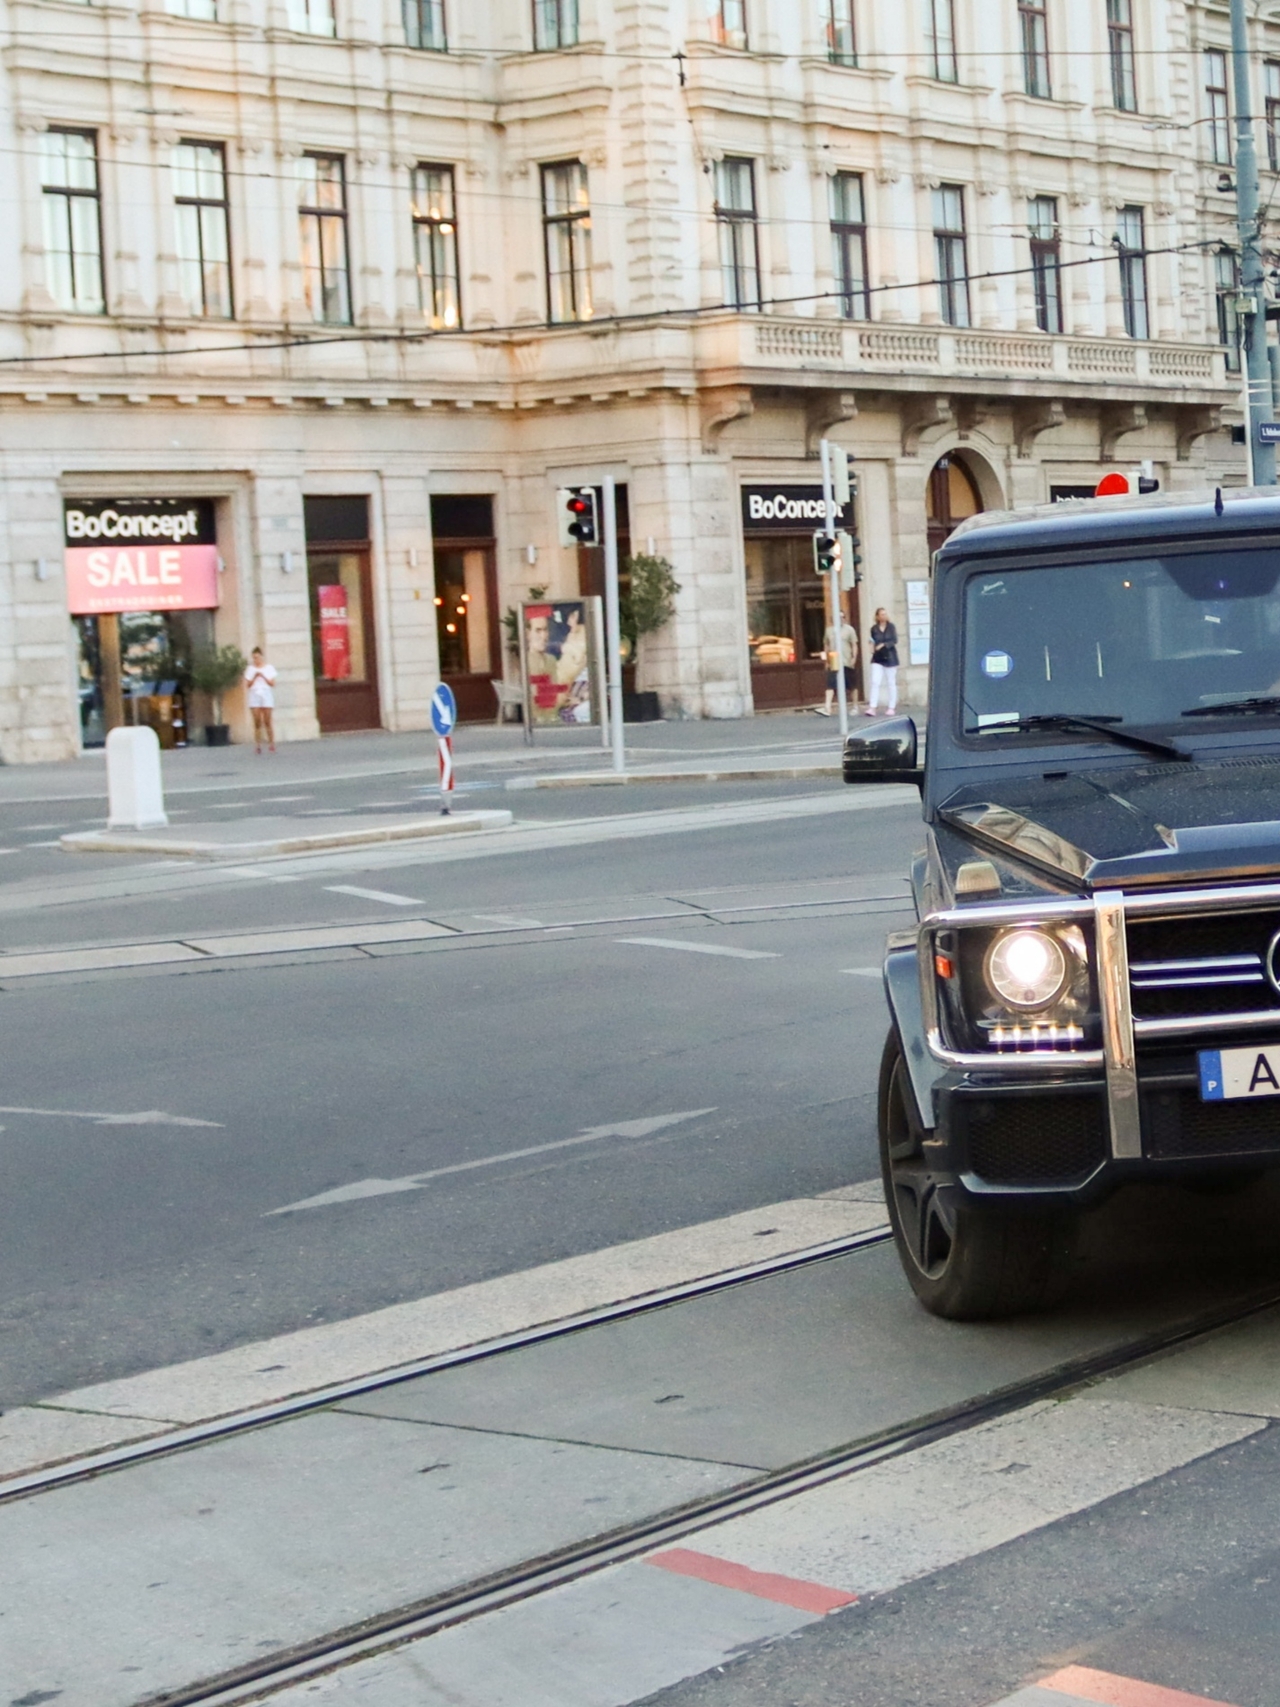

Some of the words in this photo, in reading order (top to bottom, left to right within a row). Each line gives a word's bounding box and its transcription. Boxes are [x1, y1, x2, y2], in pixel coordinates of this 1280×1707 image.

[66, 510, 198, 542] BoConcept
[87, 550, 182, 587] SALE
[1207, 1080, 1218, 1092] P
